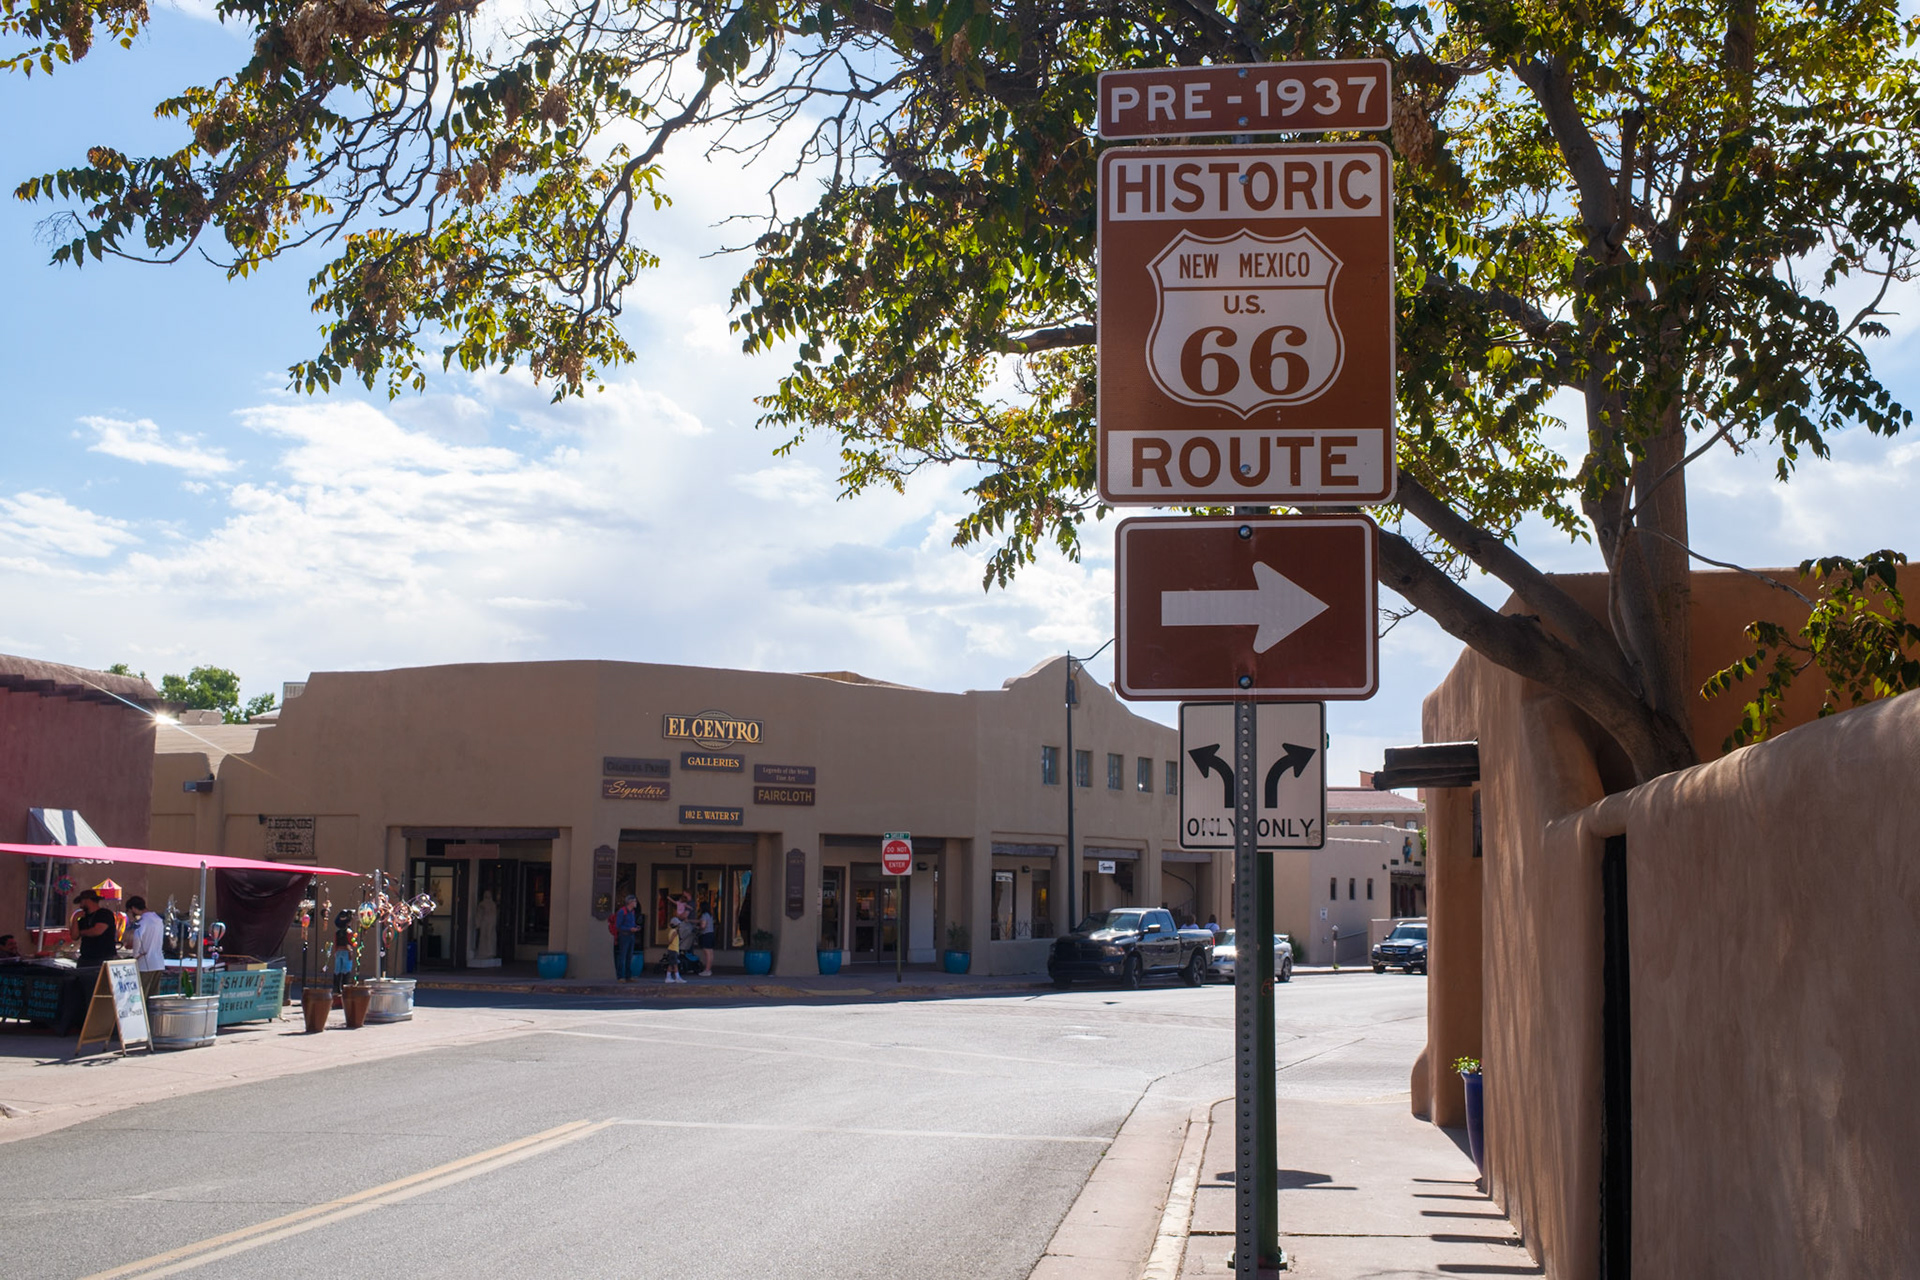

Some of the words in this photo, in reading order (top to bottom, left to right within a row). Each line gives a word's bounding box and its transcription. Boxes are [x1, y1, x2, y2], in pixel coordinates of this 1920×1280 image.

[1117, 160, 1373, 213] HISTORIC
[1179, 252, 1219, 279] NEW
[1239, 252, 1310, 278] MEXICO
[1224, 295, 1266, 314] U.S.
[1180, 325, 1310, 396] 66
[1132, 436, 1359, 487] ROUTE
[668, 717, 689, 736] EL
[692, 719, 760, 743] CENTRO
[687, 756, 740, 768] GALLERIES
[608, 780, 666, 798] Signature
[758, 789, 812, 802] FAIRCLOTH
[267, 818, 312, 829] LEGENDS
[685, 810, 696, 819] 102
[704, 811, 729, 820] WATER
[730, 812, 740, 821] ST
[1257, 818, 1315, 837] ONLY
[275, 842, 303, 853] WEST
[223, 974, 261, 989] SHIWI
[220, 1000, 254, 1012] JEWELRY
